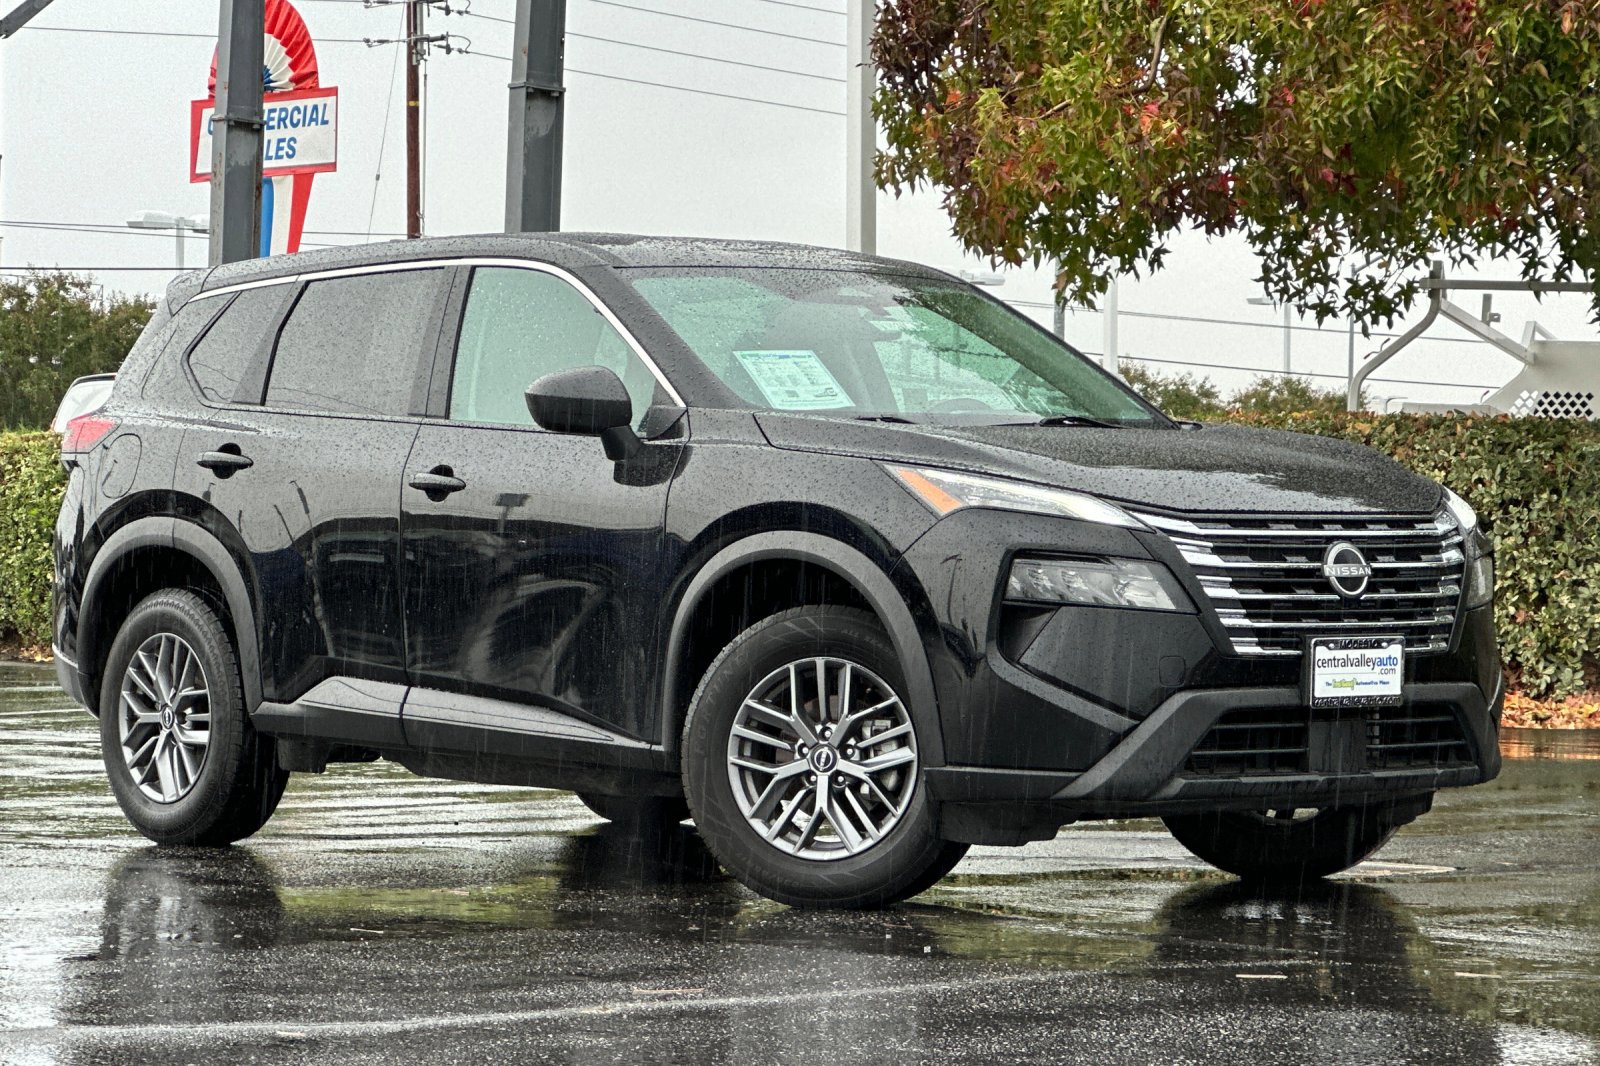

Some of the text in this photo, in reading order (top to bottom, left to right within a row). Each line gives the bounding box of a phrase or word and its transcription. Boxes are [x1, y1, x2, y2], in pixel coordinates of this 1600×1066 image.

[1326, 566, 1372, 576] NISSAN
[1316, 653, 1398, 671] centralvalleyauto
[1378, 667, 1396, 675] .com
